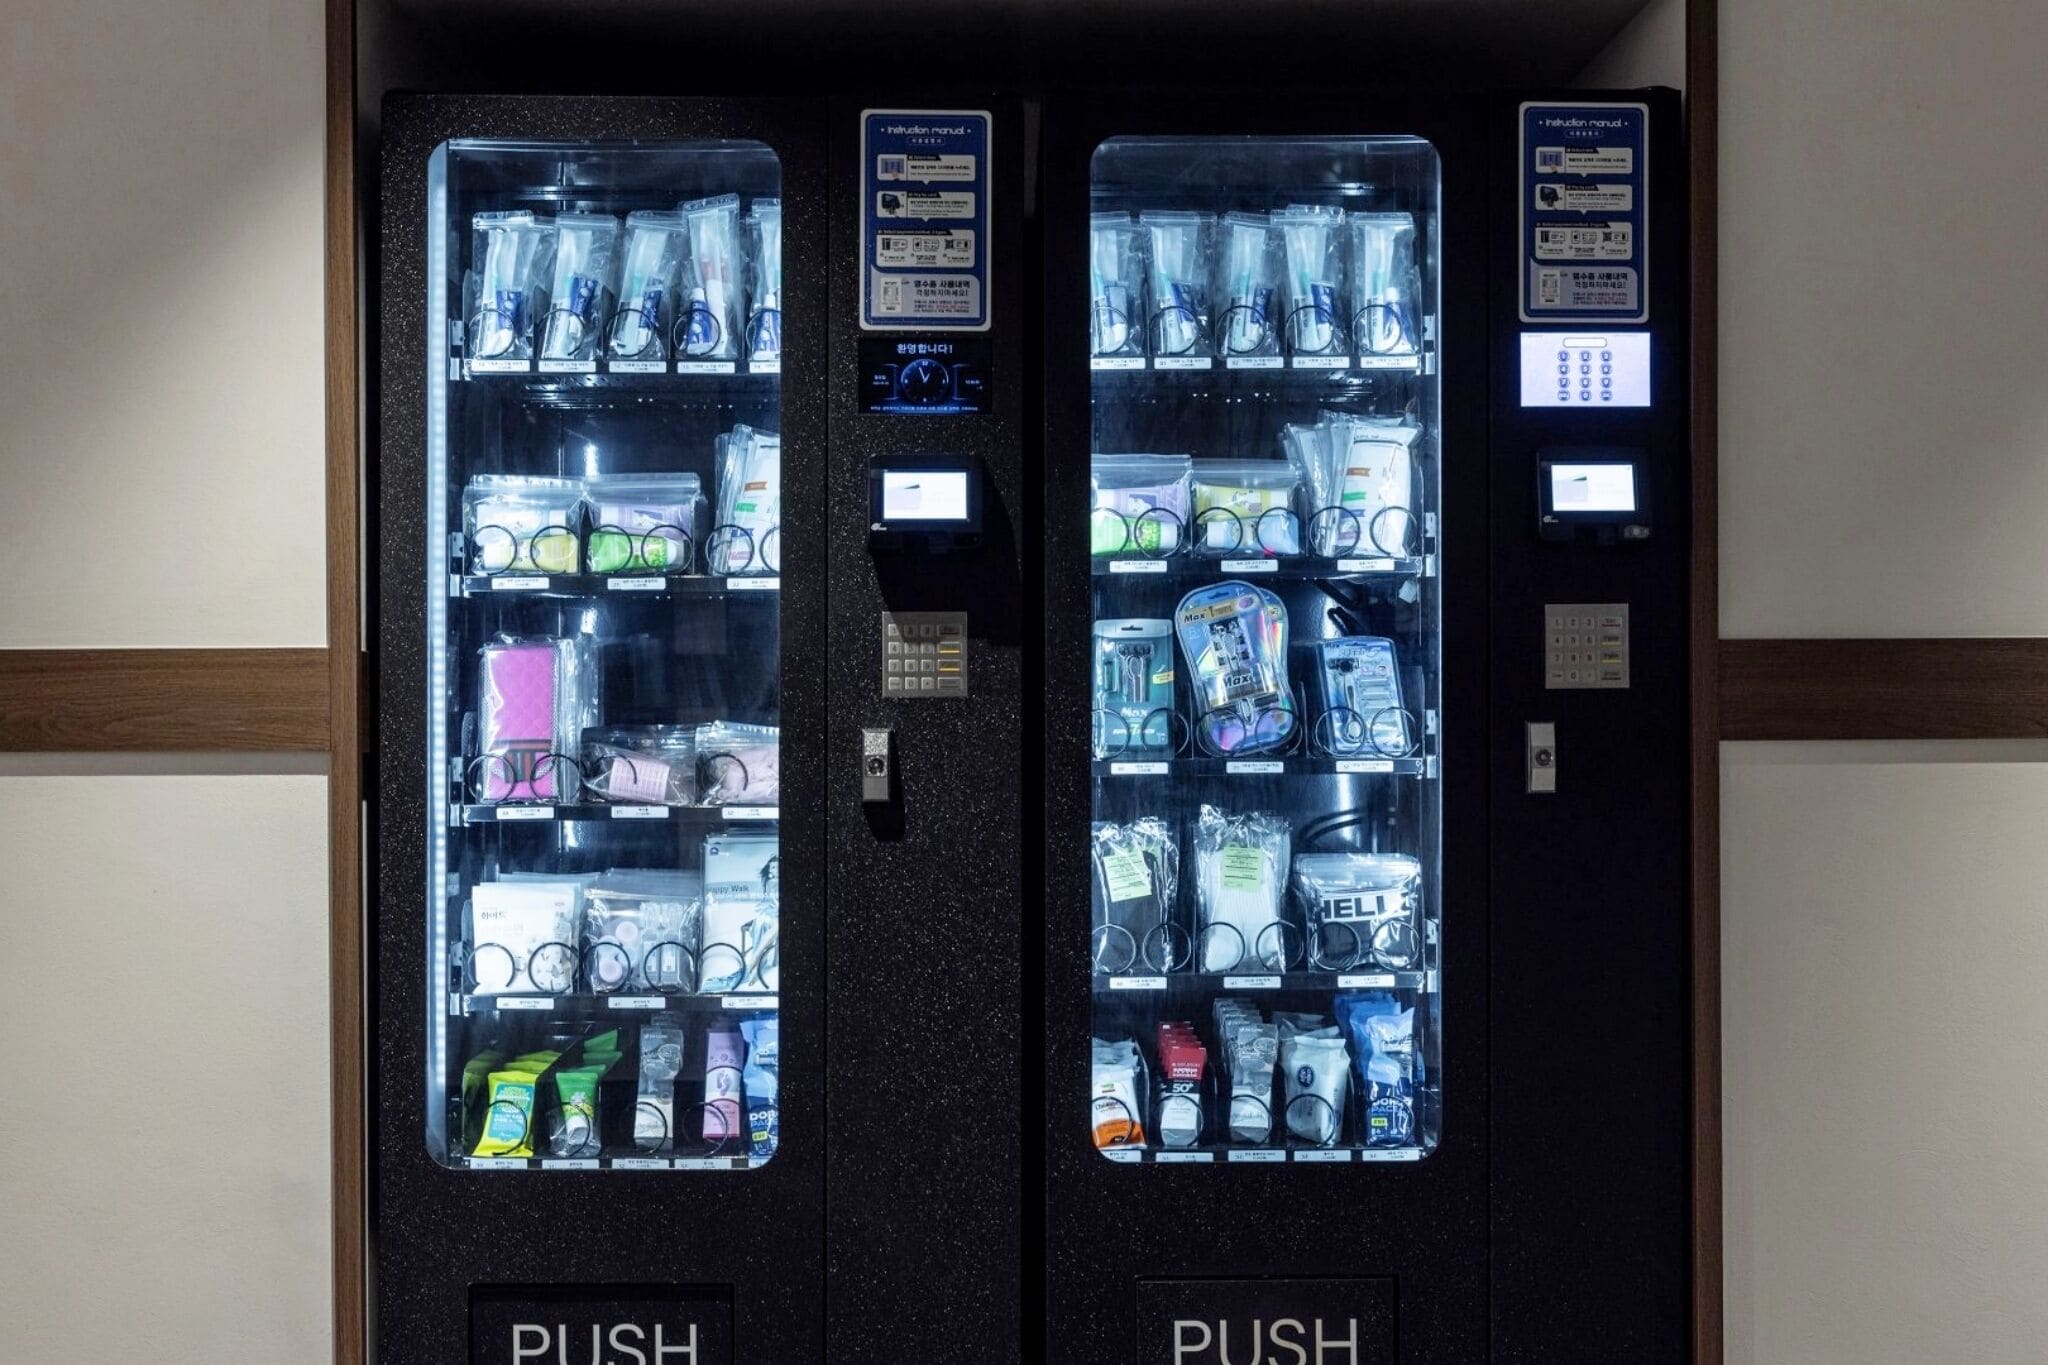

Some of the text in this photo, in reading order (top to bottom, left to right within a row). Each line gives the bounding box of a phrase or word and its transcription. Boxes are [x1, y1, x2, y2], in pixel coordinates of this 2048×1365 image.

[1589, 118, 1622, 127] manual
[931, 125, 965, 135] manual
[896, 343, 953, 354] 환영합니다!
[1184, 613, 1205, 622] Max
[731, 884, 749, 892] Walk
[511, 1323, 699, 1365] PUSH
[1173, 1319, 1360, 1365] PUSH
